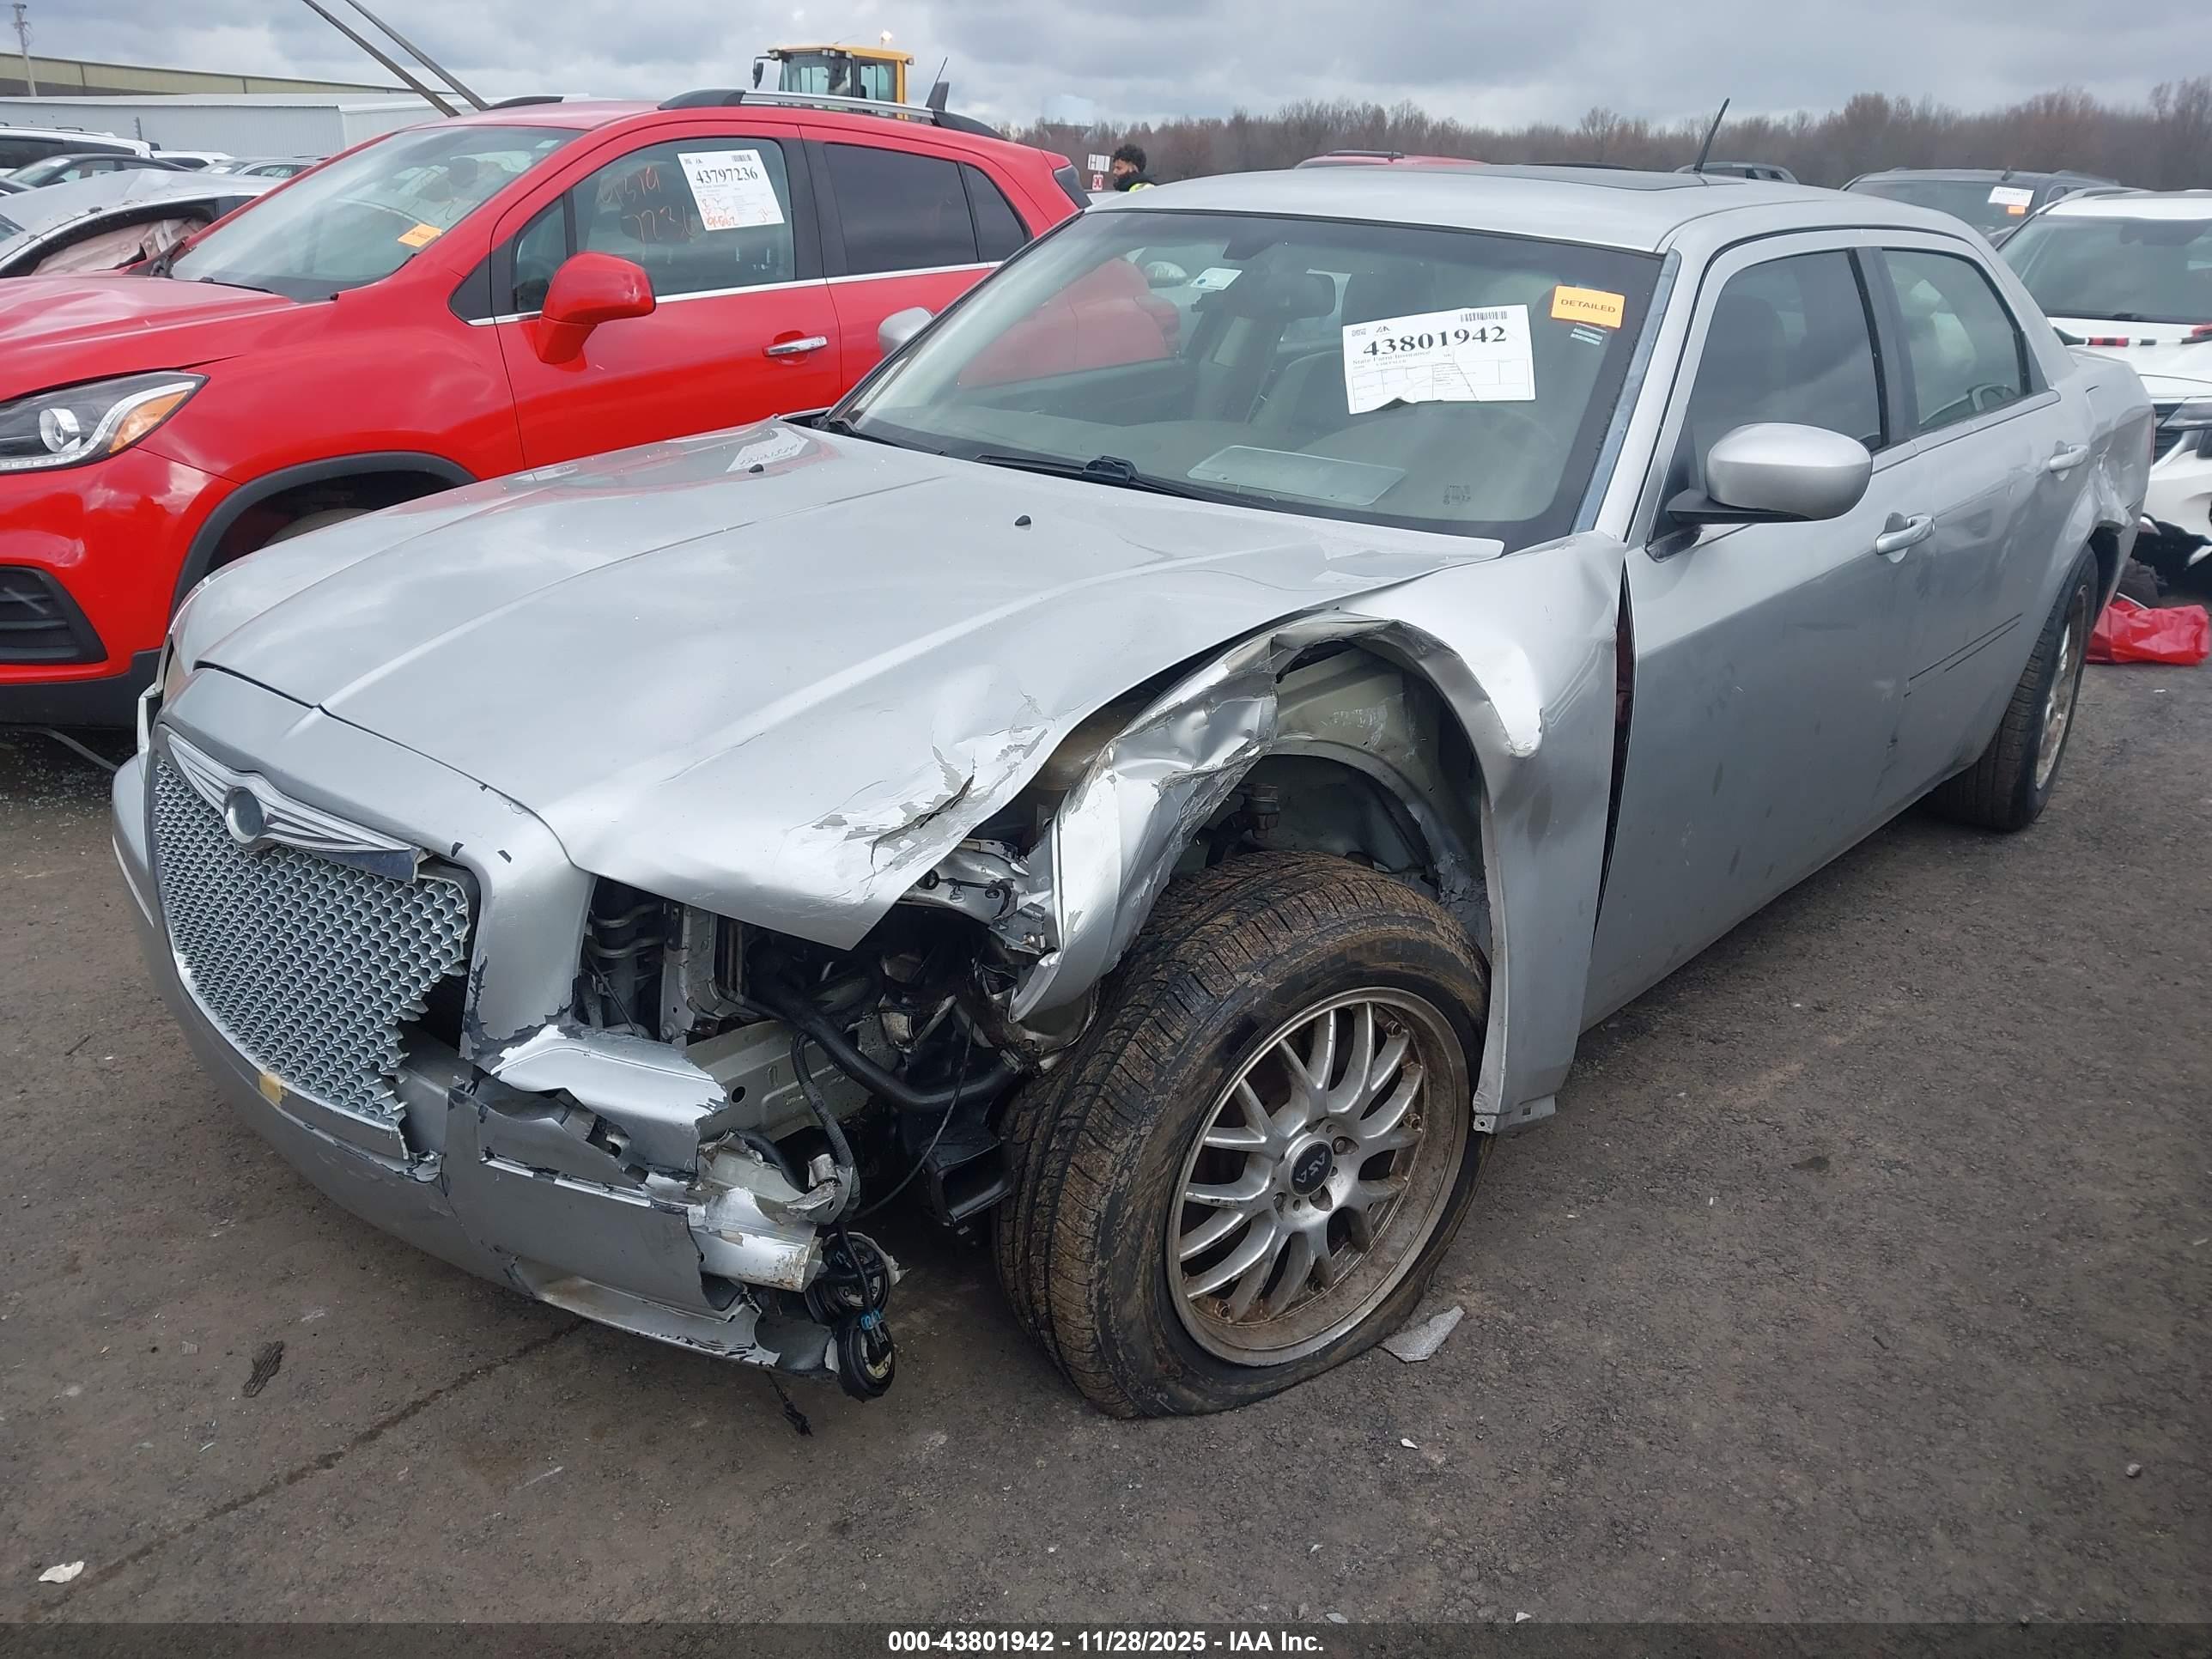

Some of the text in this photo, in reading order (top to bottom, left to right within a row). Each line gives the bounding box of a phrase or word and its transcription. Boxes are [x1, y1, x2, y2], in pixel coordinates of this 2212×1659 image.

[696, 167, 758, 184] 43797236
[1561, 299, 1616, 313] DETAILED
[1363, 325, 1507, 356] 43801942
